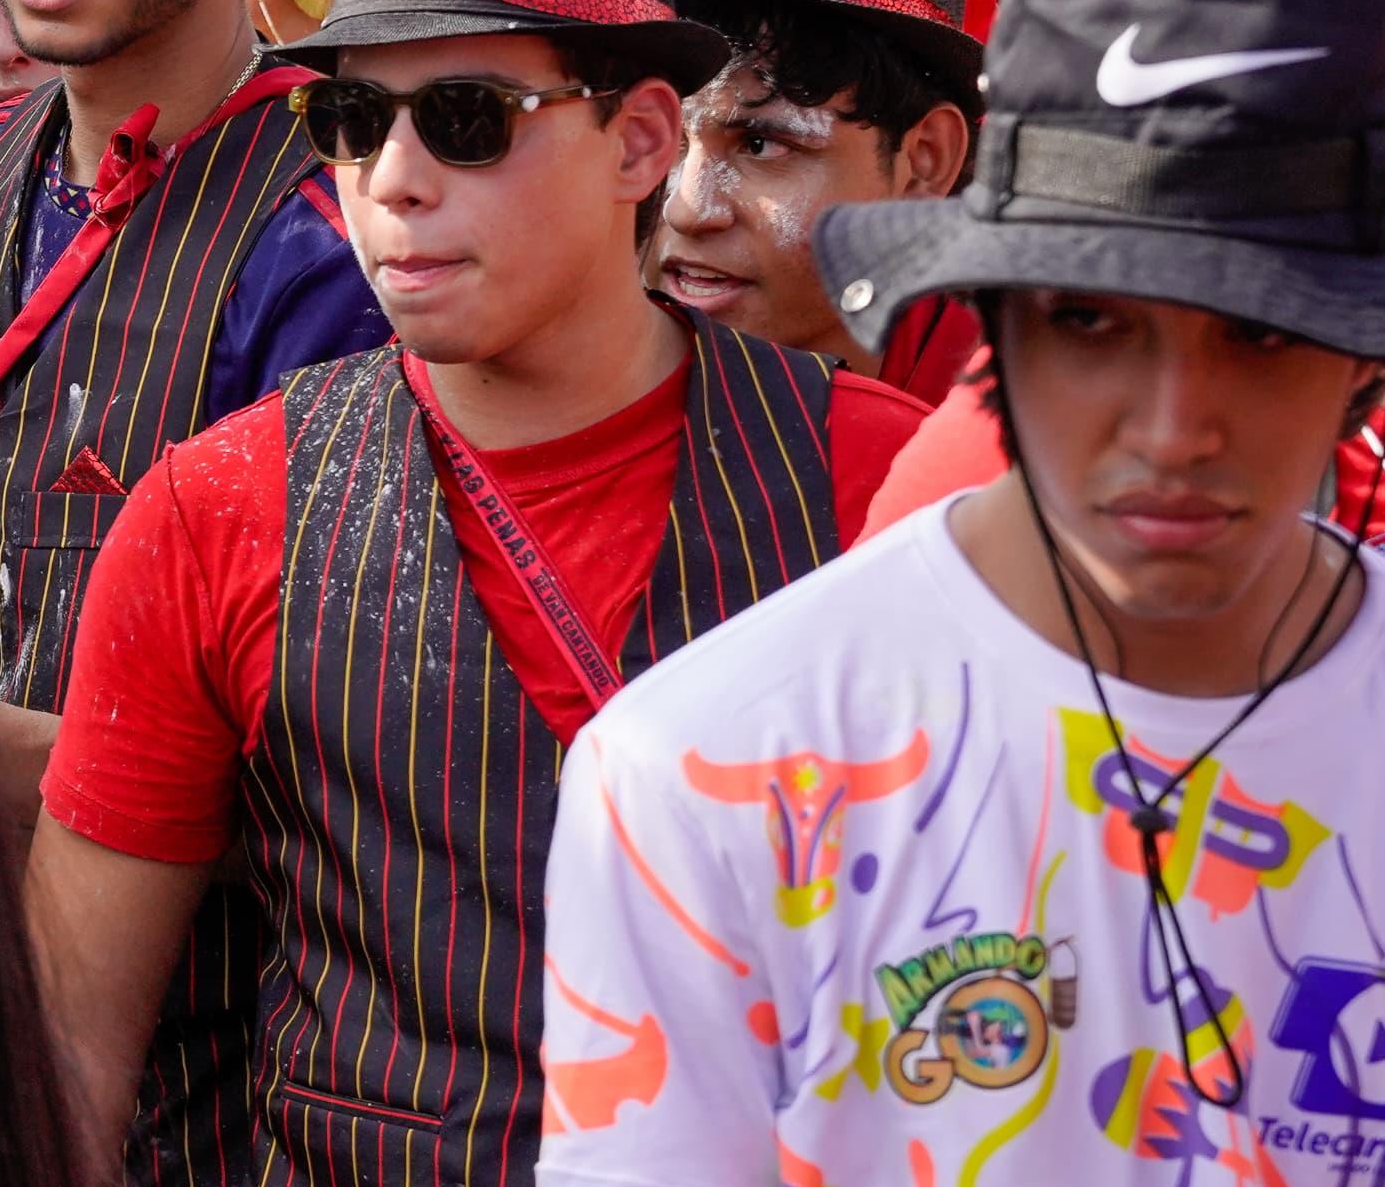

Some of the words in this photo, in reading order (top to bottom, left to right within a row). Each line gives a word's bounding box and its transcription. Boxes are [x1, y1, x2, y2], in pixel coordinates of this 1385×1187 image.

[478, 493, 536, 570] PENAS
[561, 619, 610, 687] CANTANDO
[874, 932, 1047, 1030] ARMANDO
[884, 975, 1049, 1105] GO
